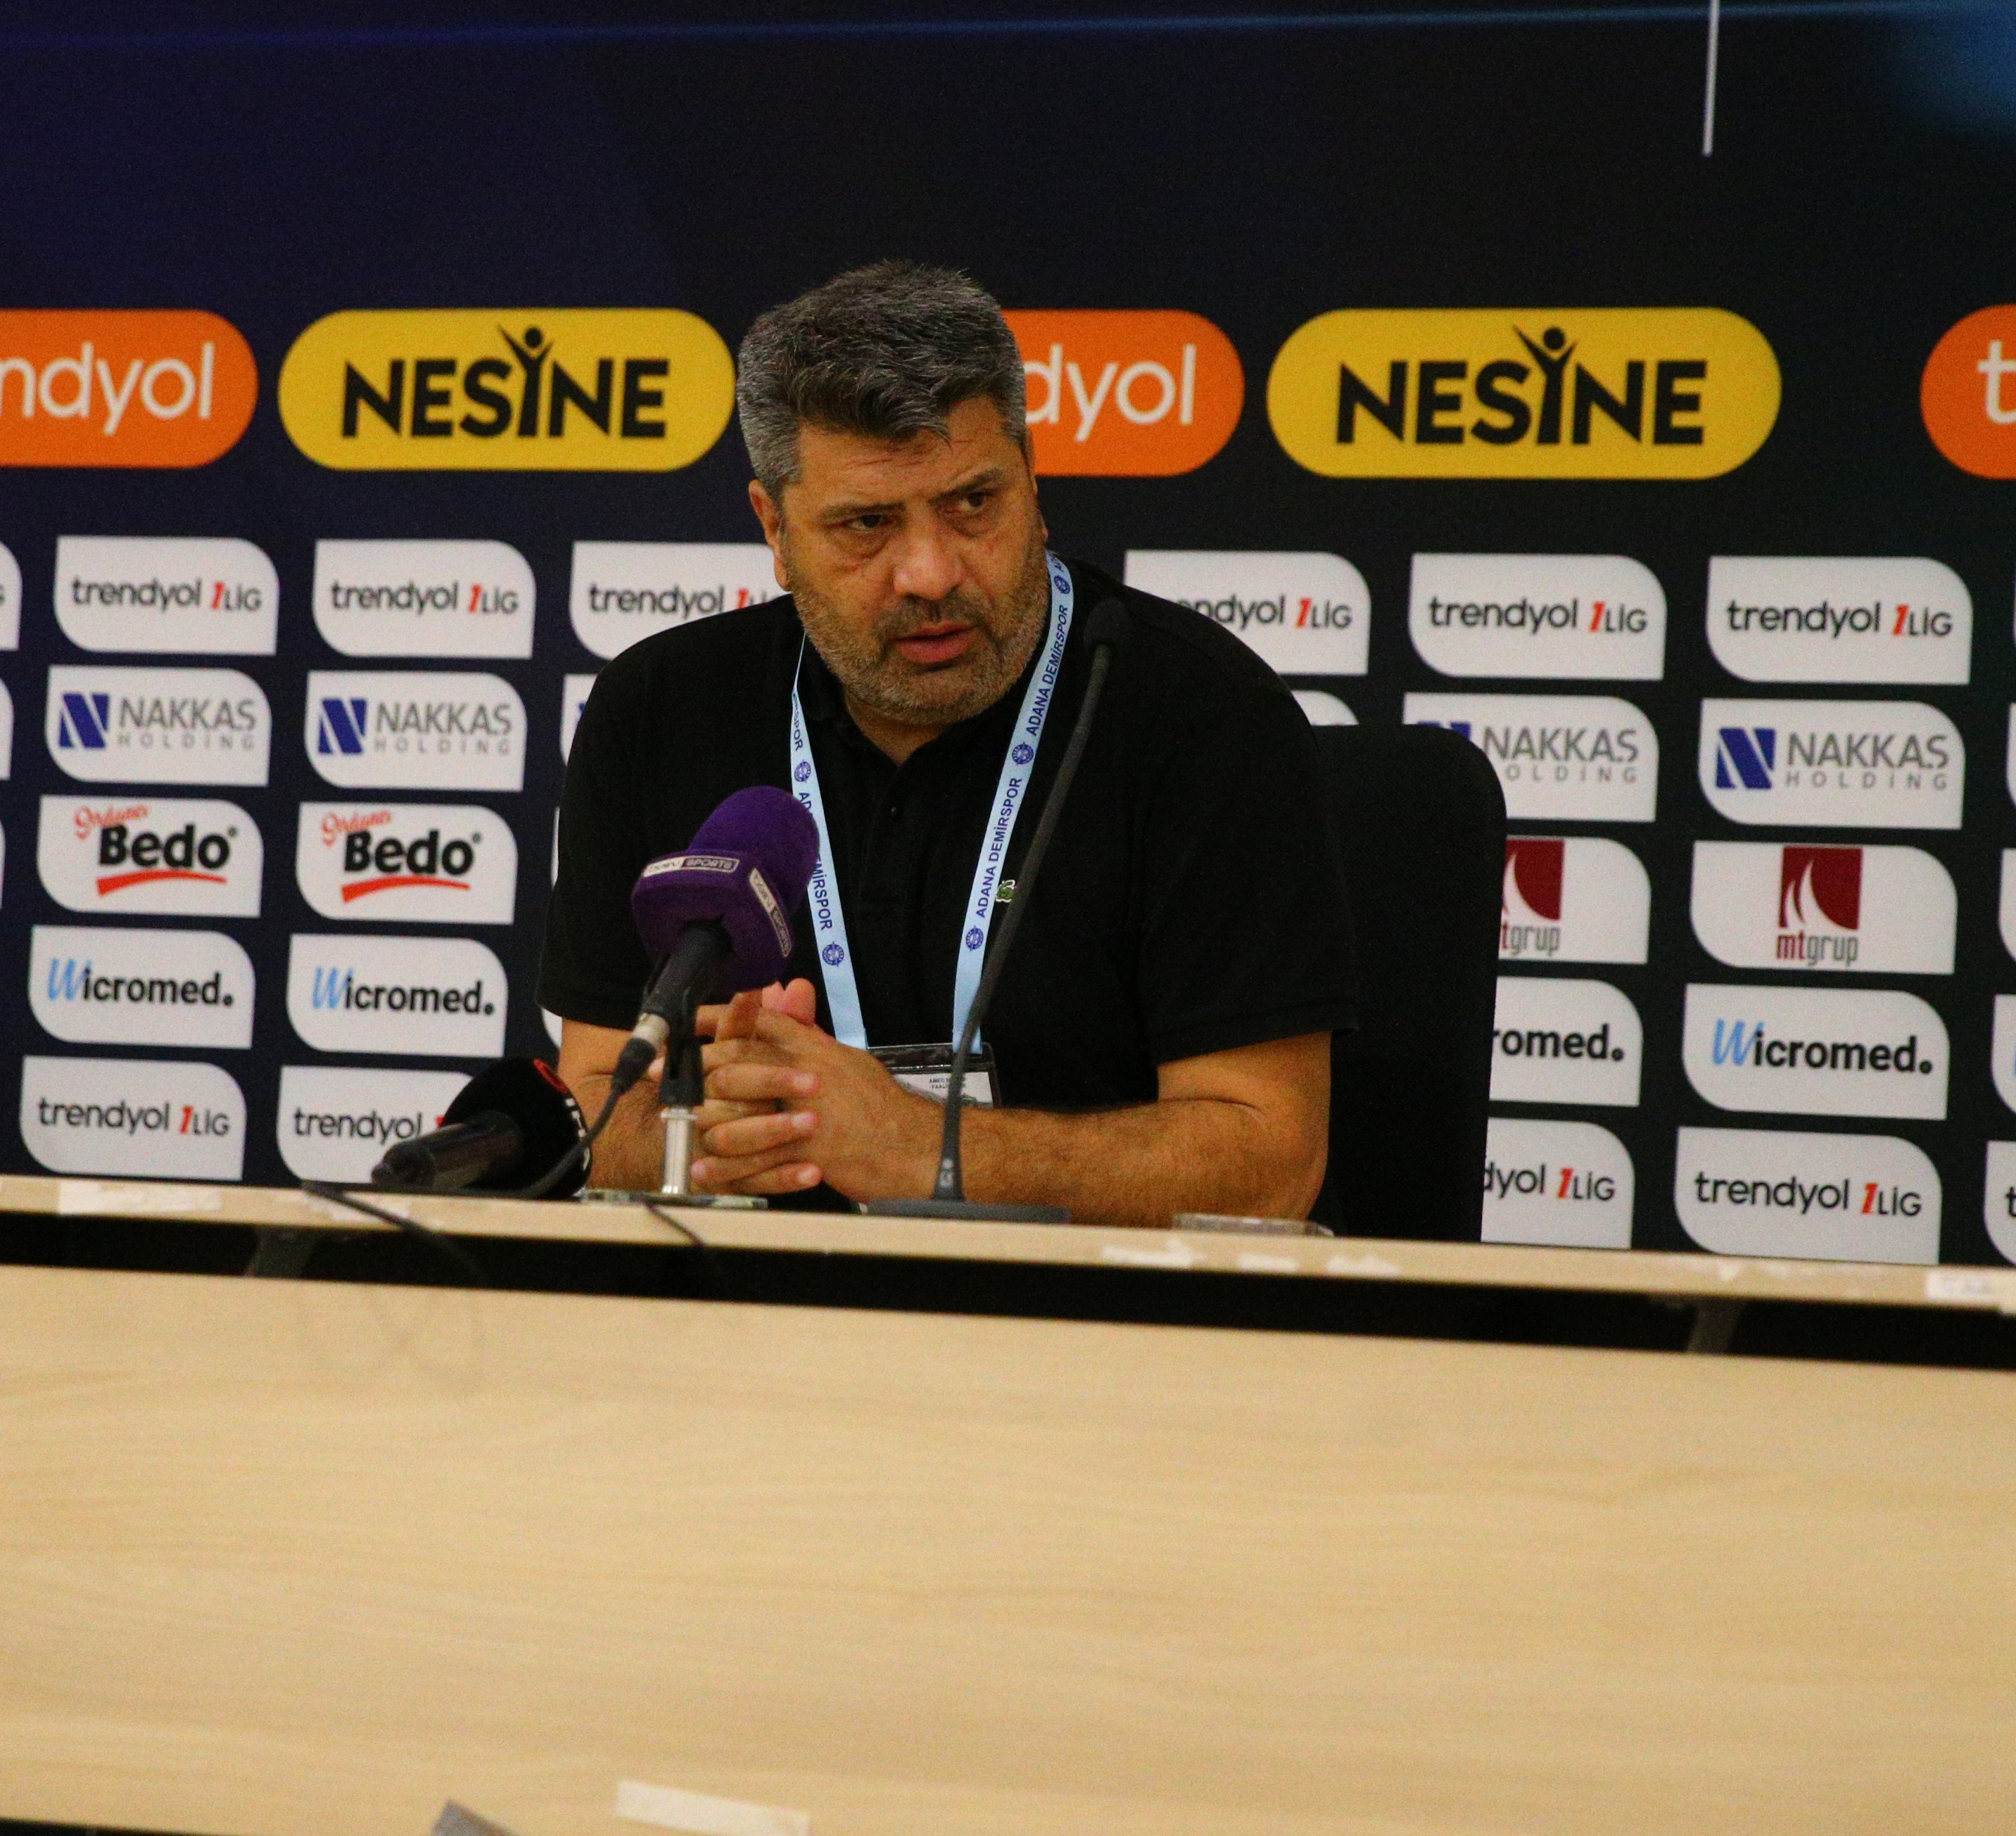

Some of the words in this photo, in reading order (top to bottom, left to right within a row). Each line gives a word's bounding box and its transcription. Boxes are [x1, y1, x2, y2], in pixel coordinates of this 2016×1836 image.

[71, 576, 203, 612] trendyol
[330, 581, 459, 615] trendyol
[589, 582, 725, 619] trendyol
[1428, 596, 1578, 635] trendyol
[1725, 600, 1882, 639] trendyol
[1026, 688, 1051, 737] ADANA
[1042, 604, 1068, 688] DEMİRSPOR
[117, 732, 255, 752] HOLDING
[373, 737, 511, 757] HOLDING
[1505, 763, 1637, 785] OLDING
[1785, 770, 1948, 792] HOLDING
[99, 823, 230, 870] Bedo
[344, 828, 474, 876] Bedo
[975, 866, 997, 918] ADANA
[988, 777, 1022, 862] DEMİRSPOR
[1776, 930, 1860, 968] mtgrup
[37, 1096, 170, 1136] trendyol
[293, 1107, 422, 1145] trendyol
[1694, 1171, 1851, 1216] trendyol
